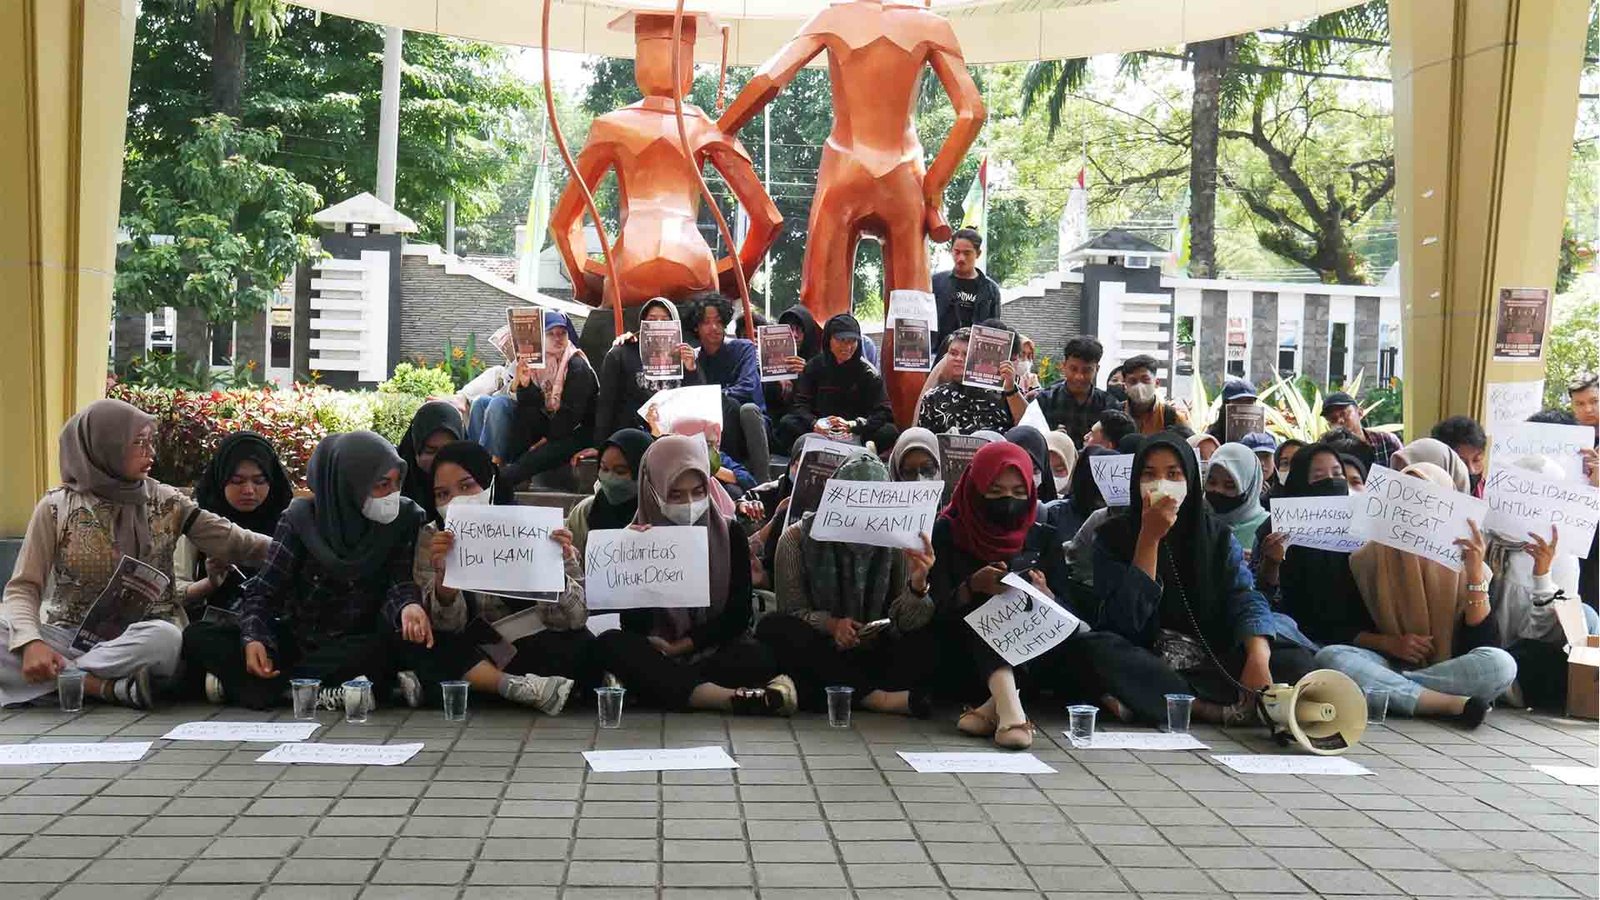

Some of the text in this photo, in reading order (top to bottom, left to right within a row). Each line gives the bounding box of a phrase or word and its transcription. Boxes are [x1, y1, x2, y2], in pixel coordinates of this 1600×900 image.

[827, 486, 941, 505] #KEMBALIKAN
[1366, 474, 1454, 518] #DOSEN
[1488, 498, 1541, 517] UNTUK
[823, 511, 856, 527] IBU
[448, 520, 549, 540] #KEMBALIKAN
[1390, 525, 1460, 562] SEPIHAK
[494, 548, 534, 567] KAMI
[587, 541, 677, 577] #Solidaritas
[1015, 620, 1066, 656] UNTUK
